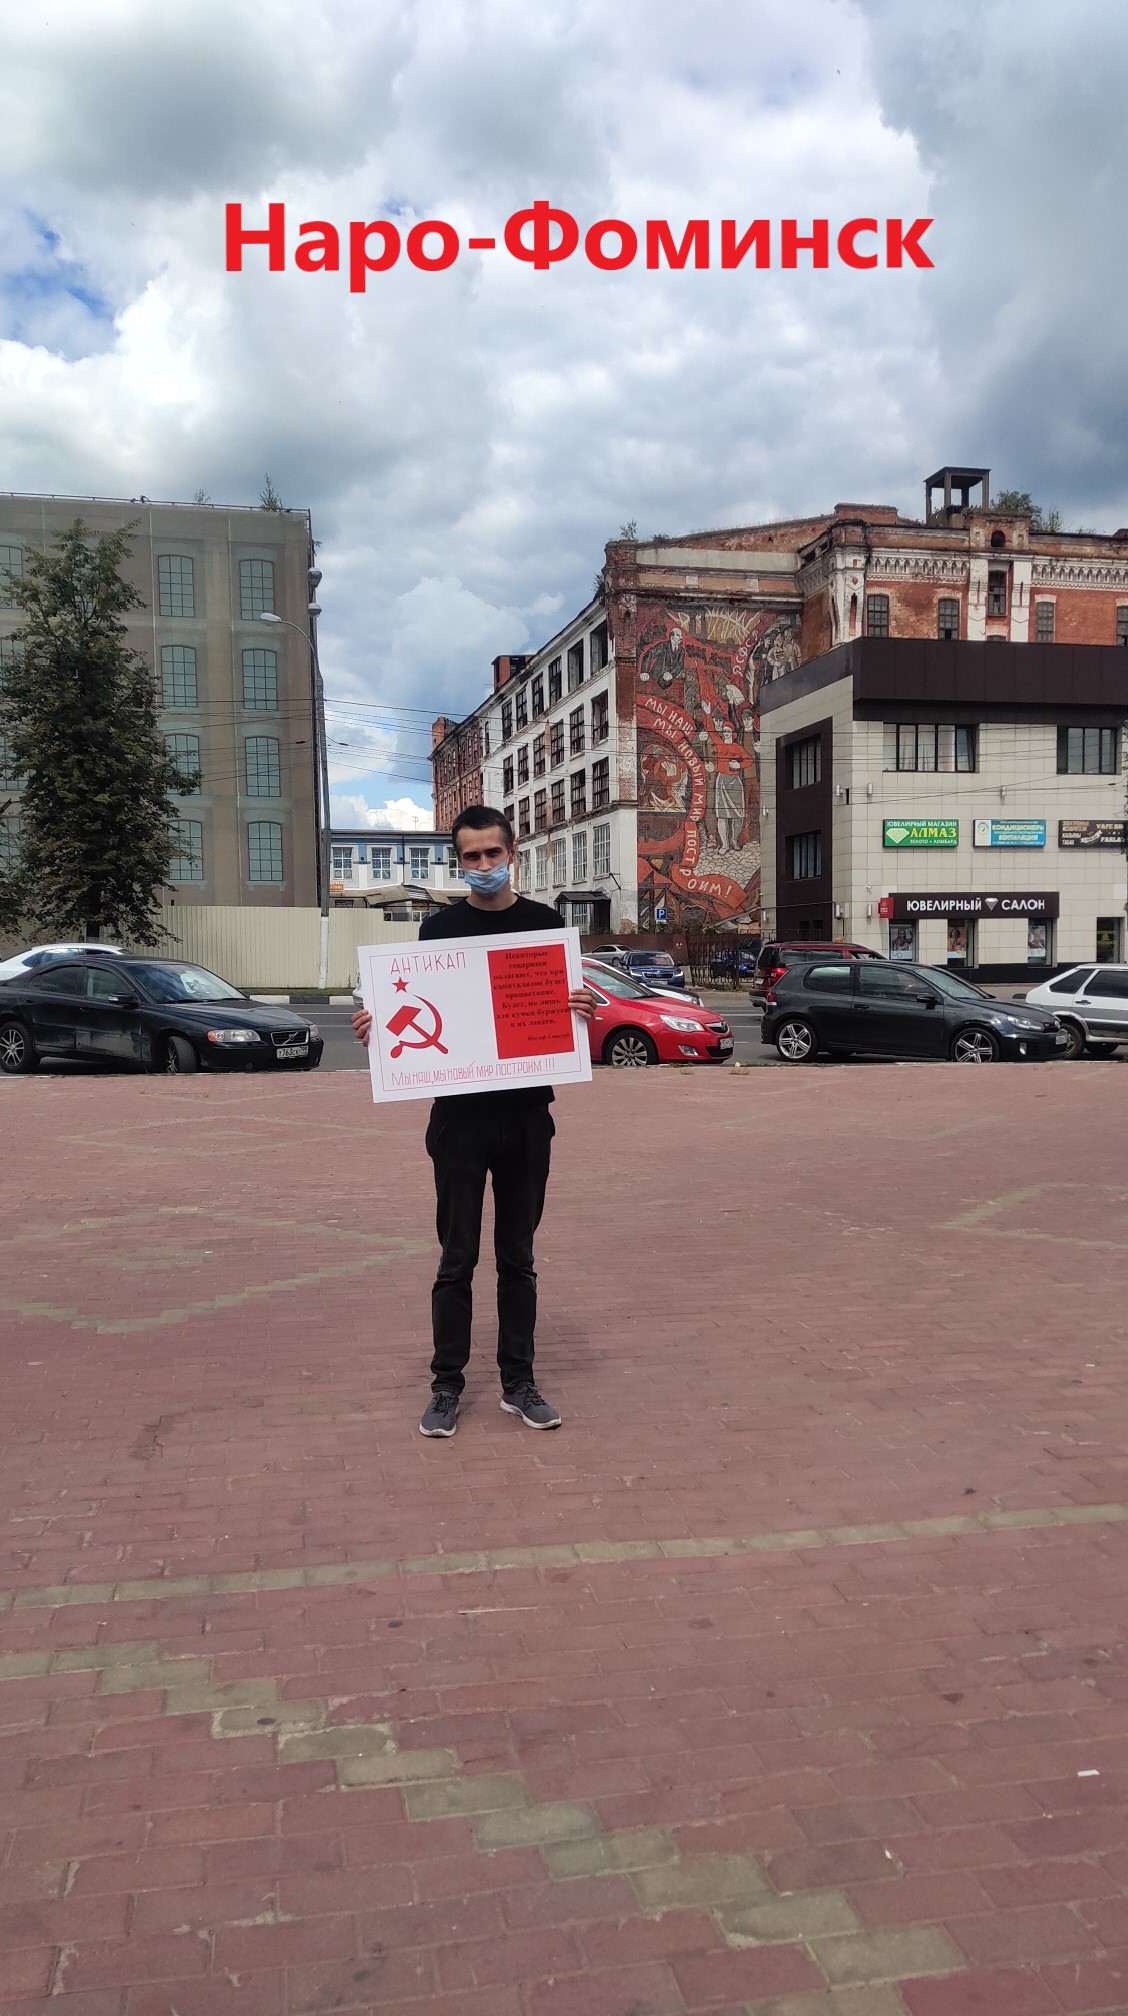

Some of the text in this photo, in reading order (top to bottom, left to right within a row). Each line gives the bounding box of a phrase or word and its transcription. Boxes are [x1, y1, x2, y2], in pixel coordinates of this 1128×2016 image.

[645, 697, 694, 736] МЫ НАШ
[653, 717, 677, 739] МЫ
[689, 793, 704, 822] МИР
[910, 827, 957, 838] АЛМАЗ
[906, 897, 1045, 912] ЮВЕЛИРНЫЙ САЛОН
[505, 951, 548, 960] Некоторые
[390, 951, 467, 976] АНТИКАП
[550, 969, 564, 977] при
[545, 979, 566, 987] будет
[511, 1010, 535, 1019] кучки
